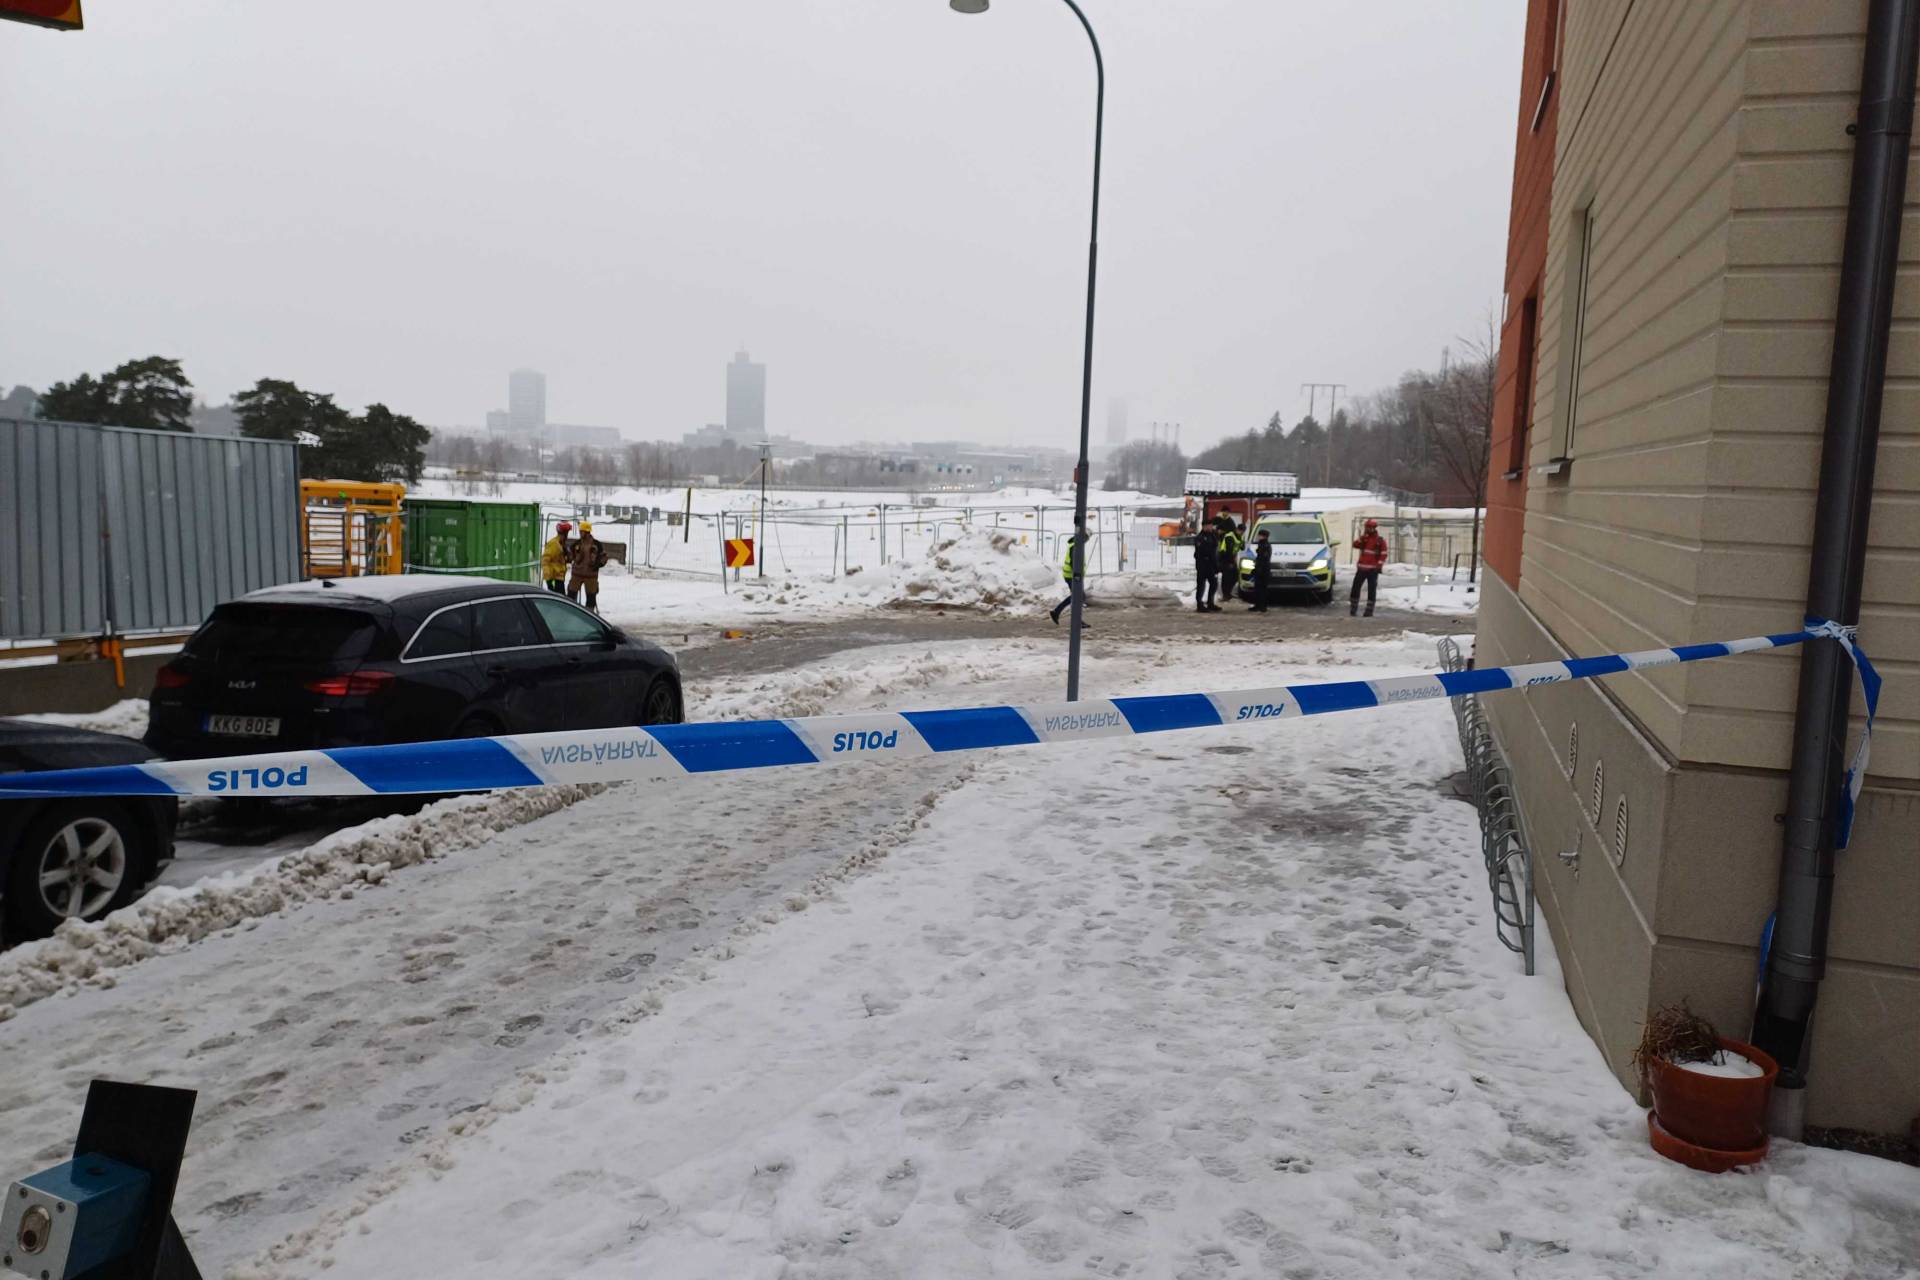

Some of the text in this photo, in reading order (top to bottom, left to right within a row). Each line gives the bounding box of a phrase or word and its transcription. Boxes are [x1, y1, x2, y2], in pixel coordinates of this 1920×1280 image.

[1237, 703, 1285, 720] POLIS
[213, 716, 241, 732] KKG
[832, 730, 898, 752] POLIS
[207, 766, 308, 791] POLIS
